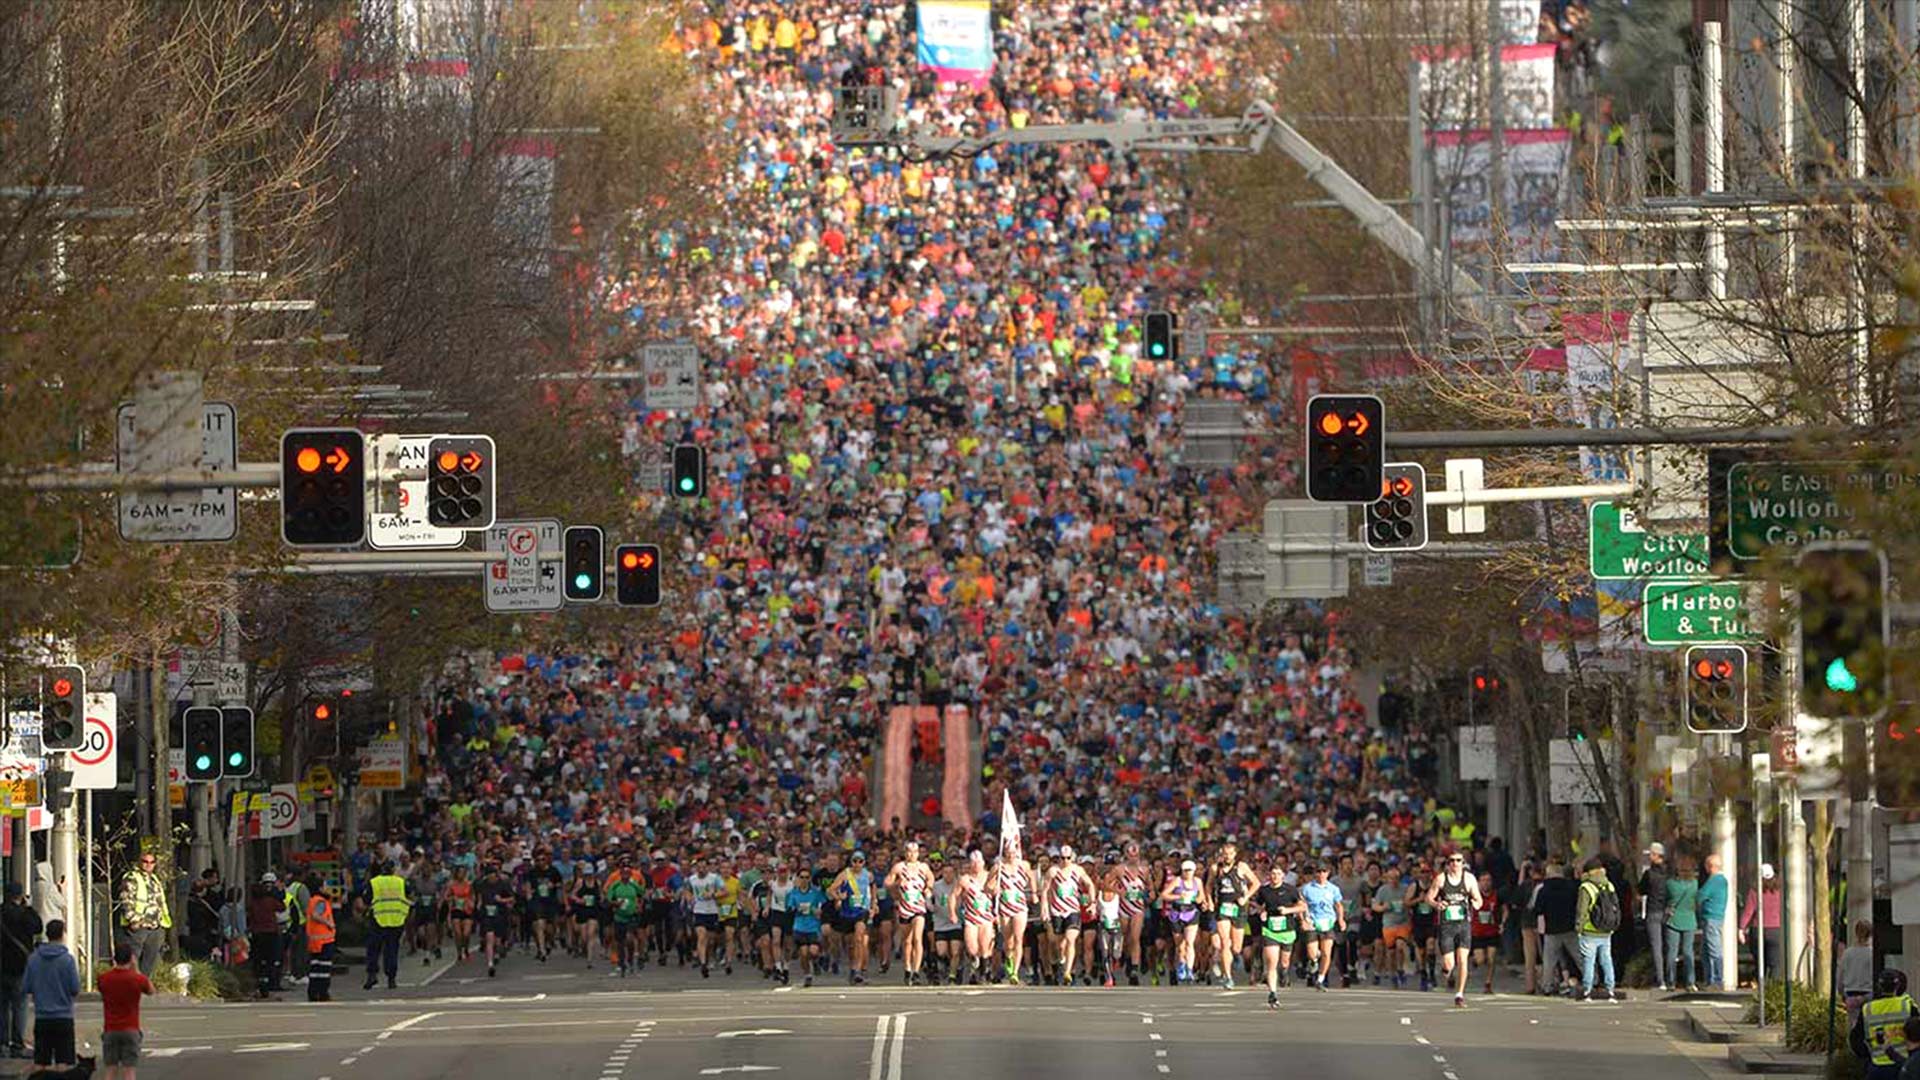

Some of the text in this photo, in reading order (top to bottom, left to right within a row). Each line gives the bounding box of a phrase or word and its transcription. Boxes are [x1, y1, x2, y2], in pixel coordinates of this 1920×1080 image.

[130, 504, 169, 519] 6AM
[191, 503, 226, 516] 7PM
[379, 518, 409, 529] 6AM
[1643, 535, 1689, 554] City
[513, 557, 530, 567] NO
[1678, 616, 1694, 635] &
[271, 802, 292, 819] 50
